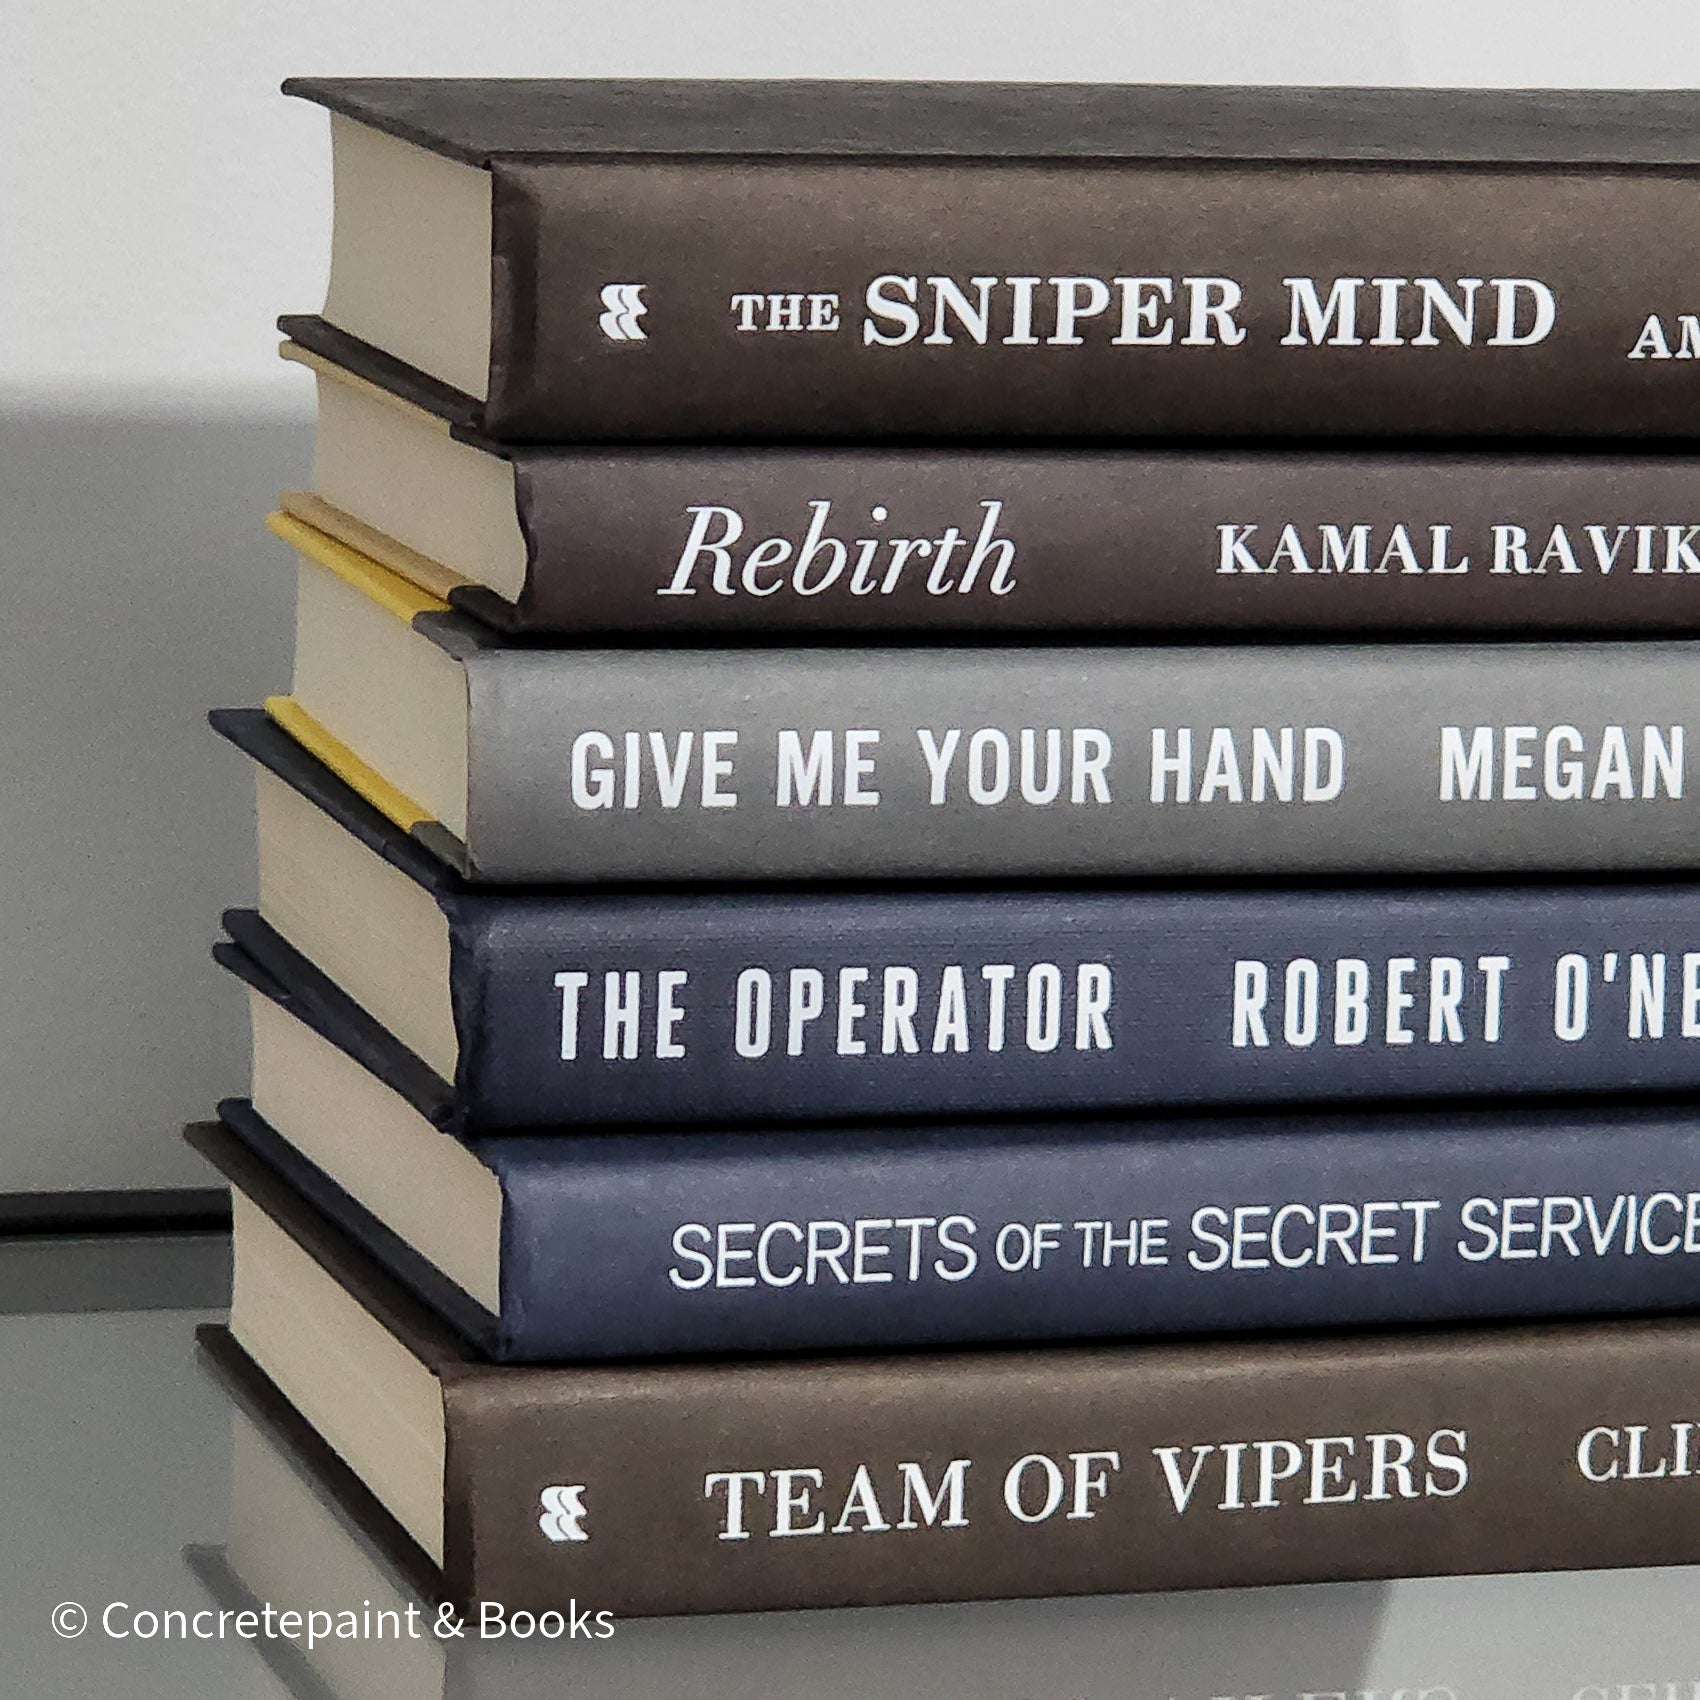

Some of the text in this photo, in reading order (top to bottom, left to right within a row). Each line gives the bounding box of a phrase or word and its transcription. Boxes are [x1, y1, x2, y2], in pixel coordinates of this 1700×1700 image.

[731, 275, 1556, 347] THE SNIPER MIND
[656, 500, 1016, 596] Rebirth
[1216, 523, 1700, 575] KAMAL RAVIK
[571, 725, 1685, 810] GIVE ME YOUR HAND MEGAN
[554, 970, 688, 1060] THE
[735, 962, 1113, 1058] OPERATOR
[1232, 955, 1511, 1048] ROBERT
[669, 1215, 977, 1290] SECRETS
[995, 1222, 1063, 1272] OF
[1073, 1219, 1170, 1268] THE
[1187, 1200, 1442, 1272] SECRET
[704, 1429, 1469, 1540] TEAM OF VIPERS
[1577, 1422, 1700, 1482] CLI
